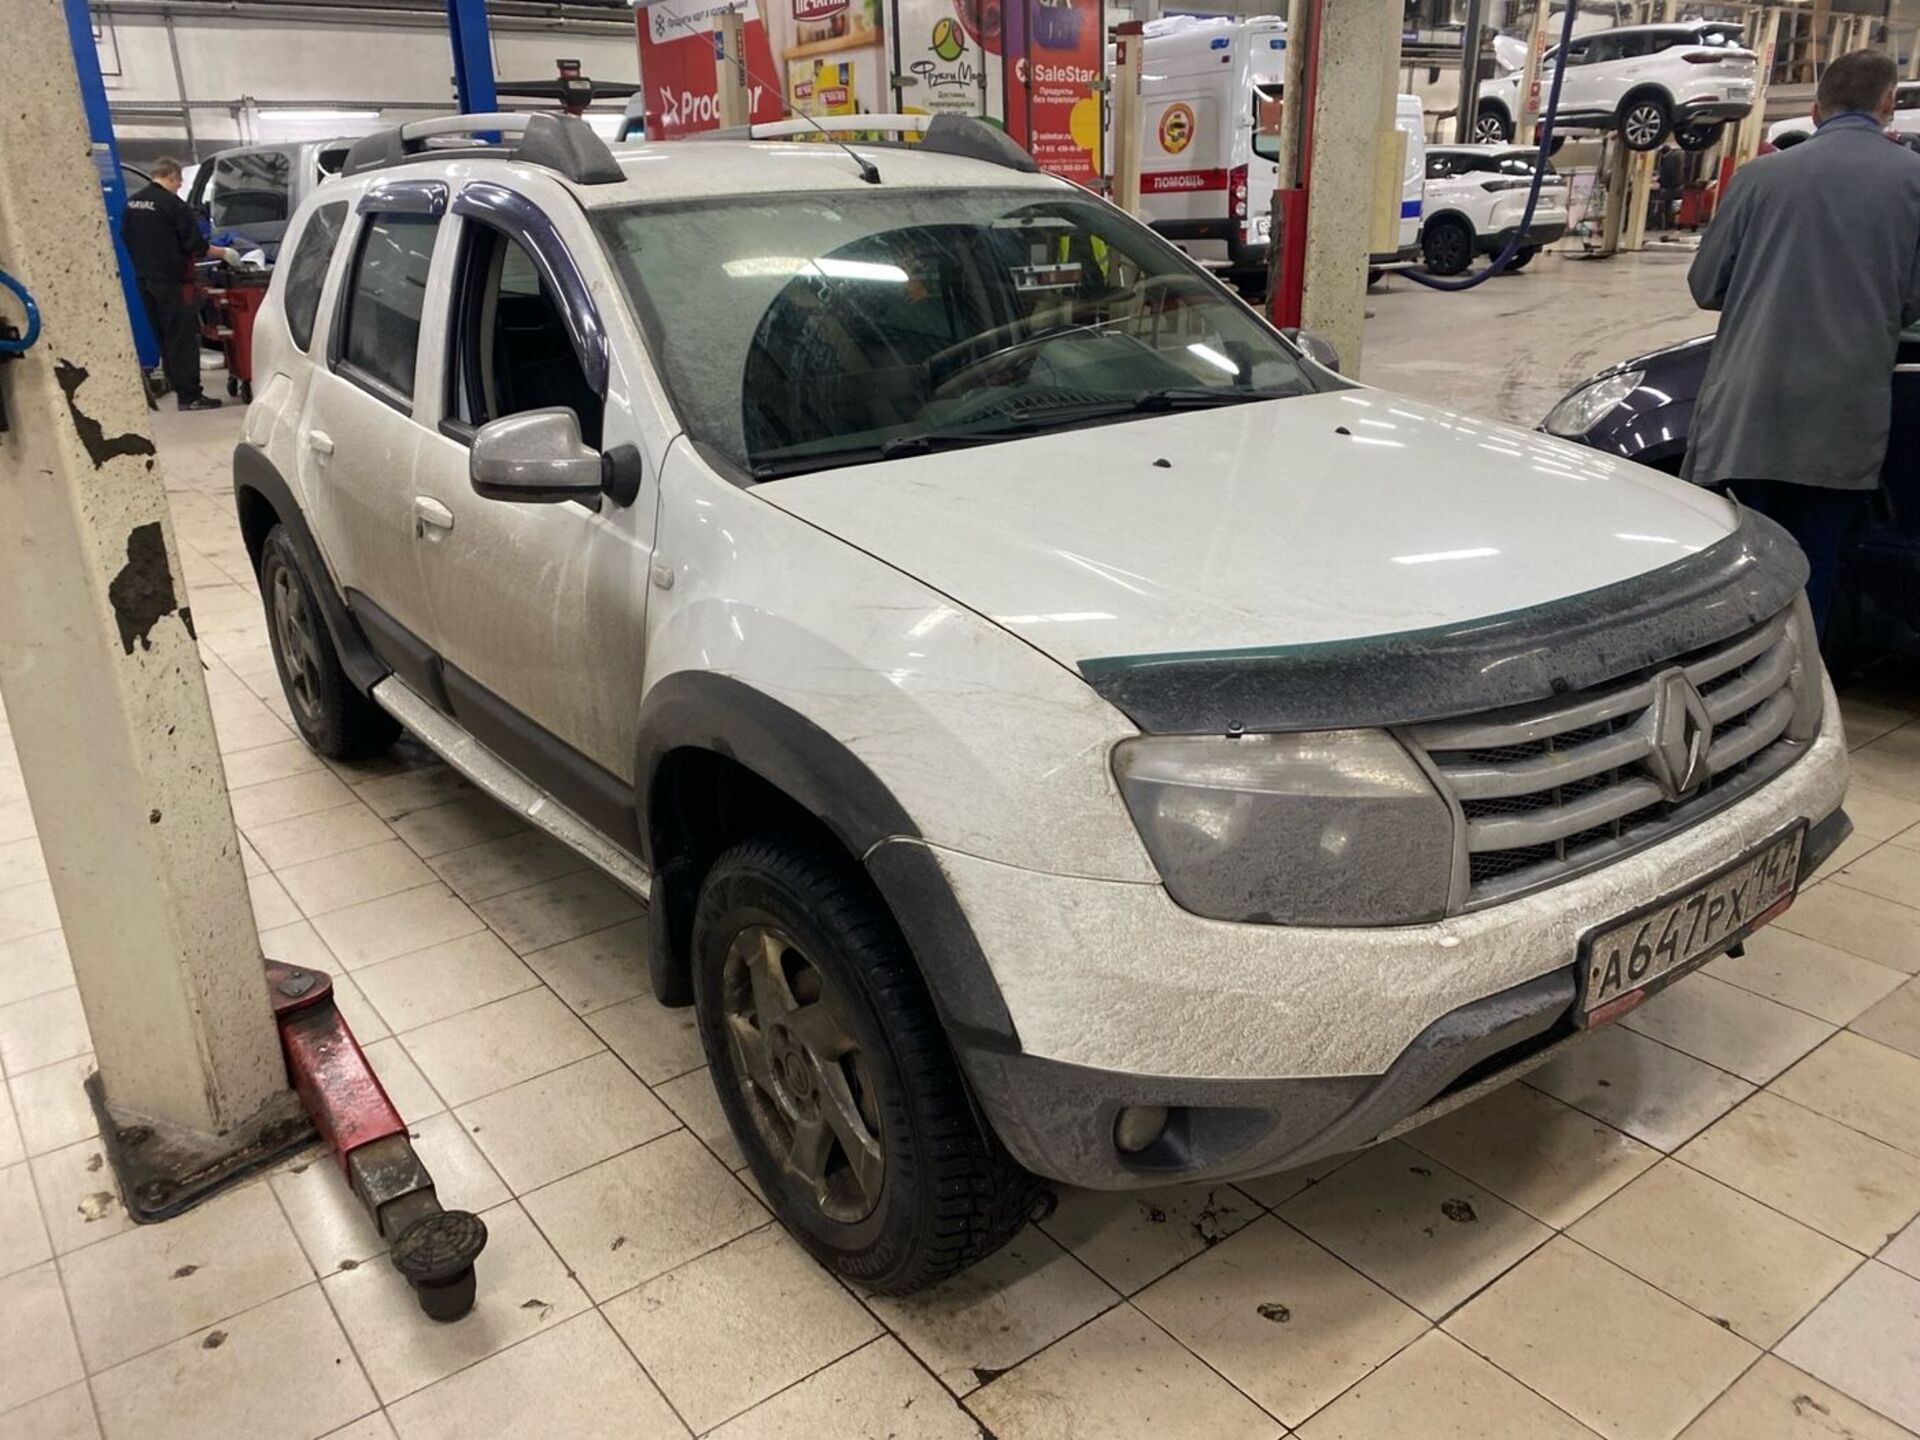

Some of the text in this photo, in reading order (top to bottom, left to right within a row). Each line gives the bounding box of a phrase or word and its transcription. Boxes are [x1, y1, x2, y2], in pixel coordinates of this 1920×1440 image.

[1035, 64, 1095, 82] SaleStar
[1154, 175, 1204, 189] ПОМОЩЬ
[1598, 879, 1749, 998] А647РХ
